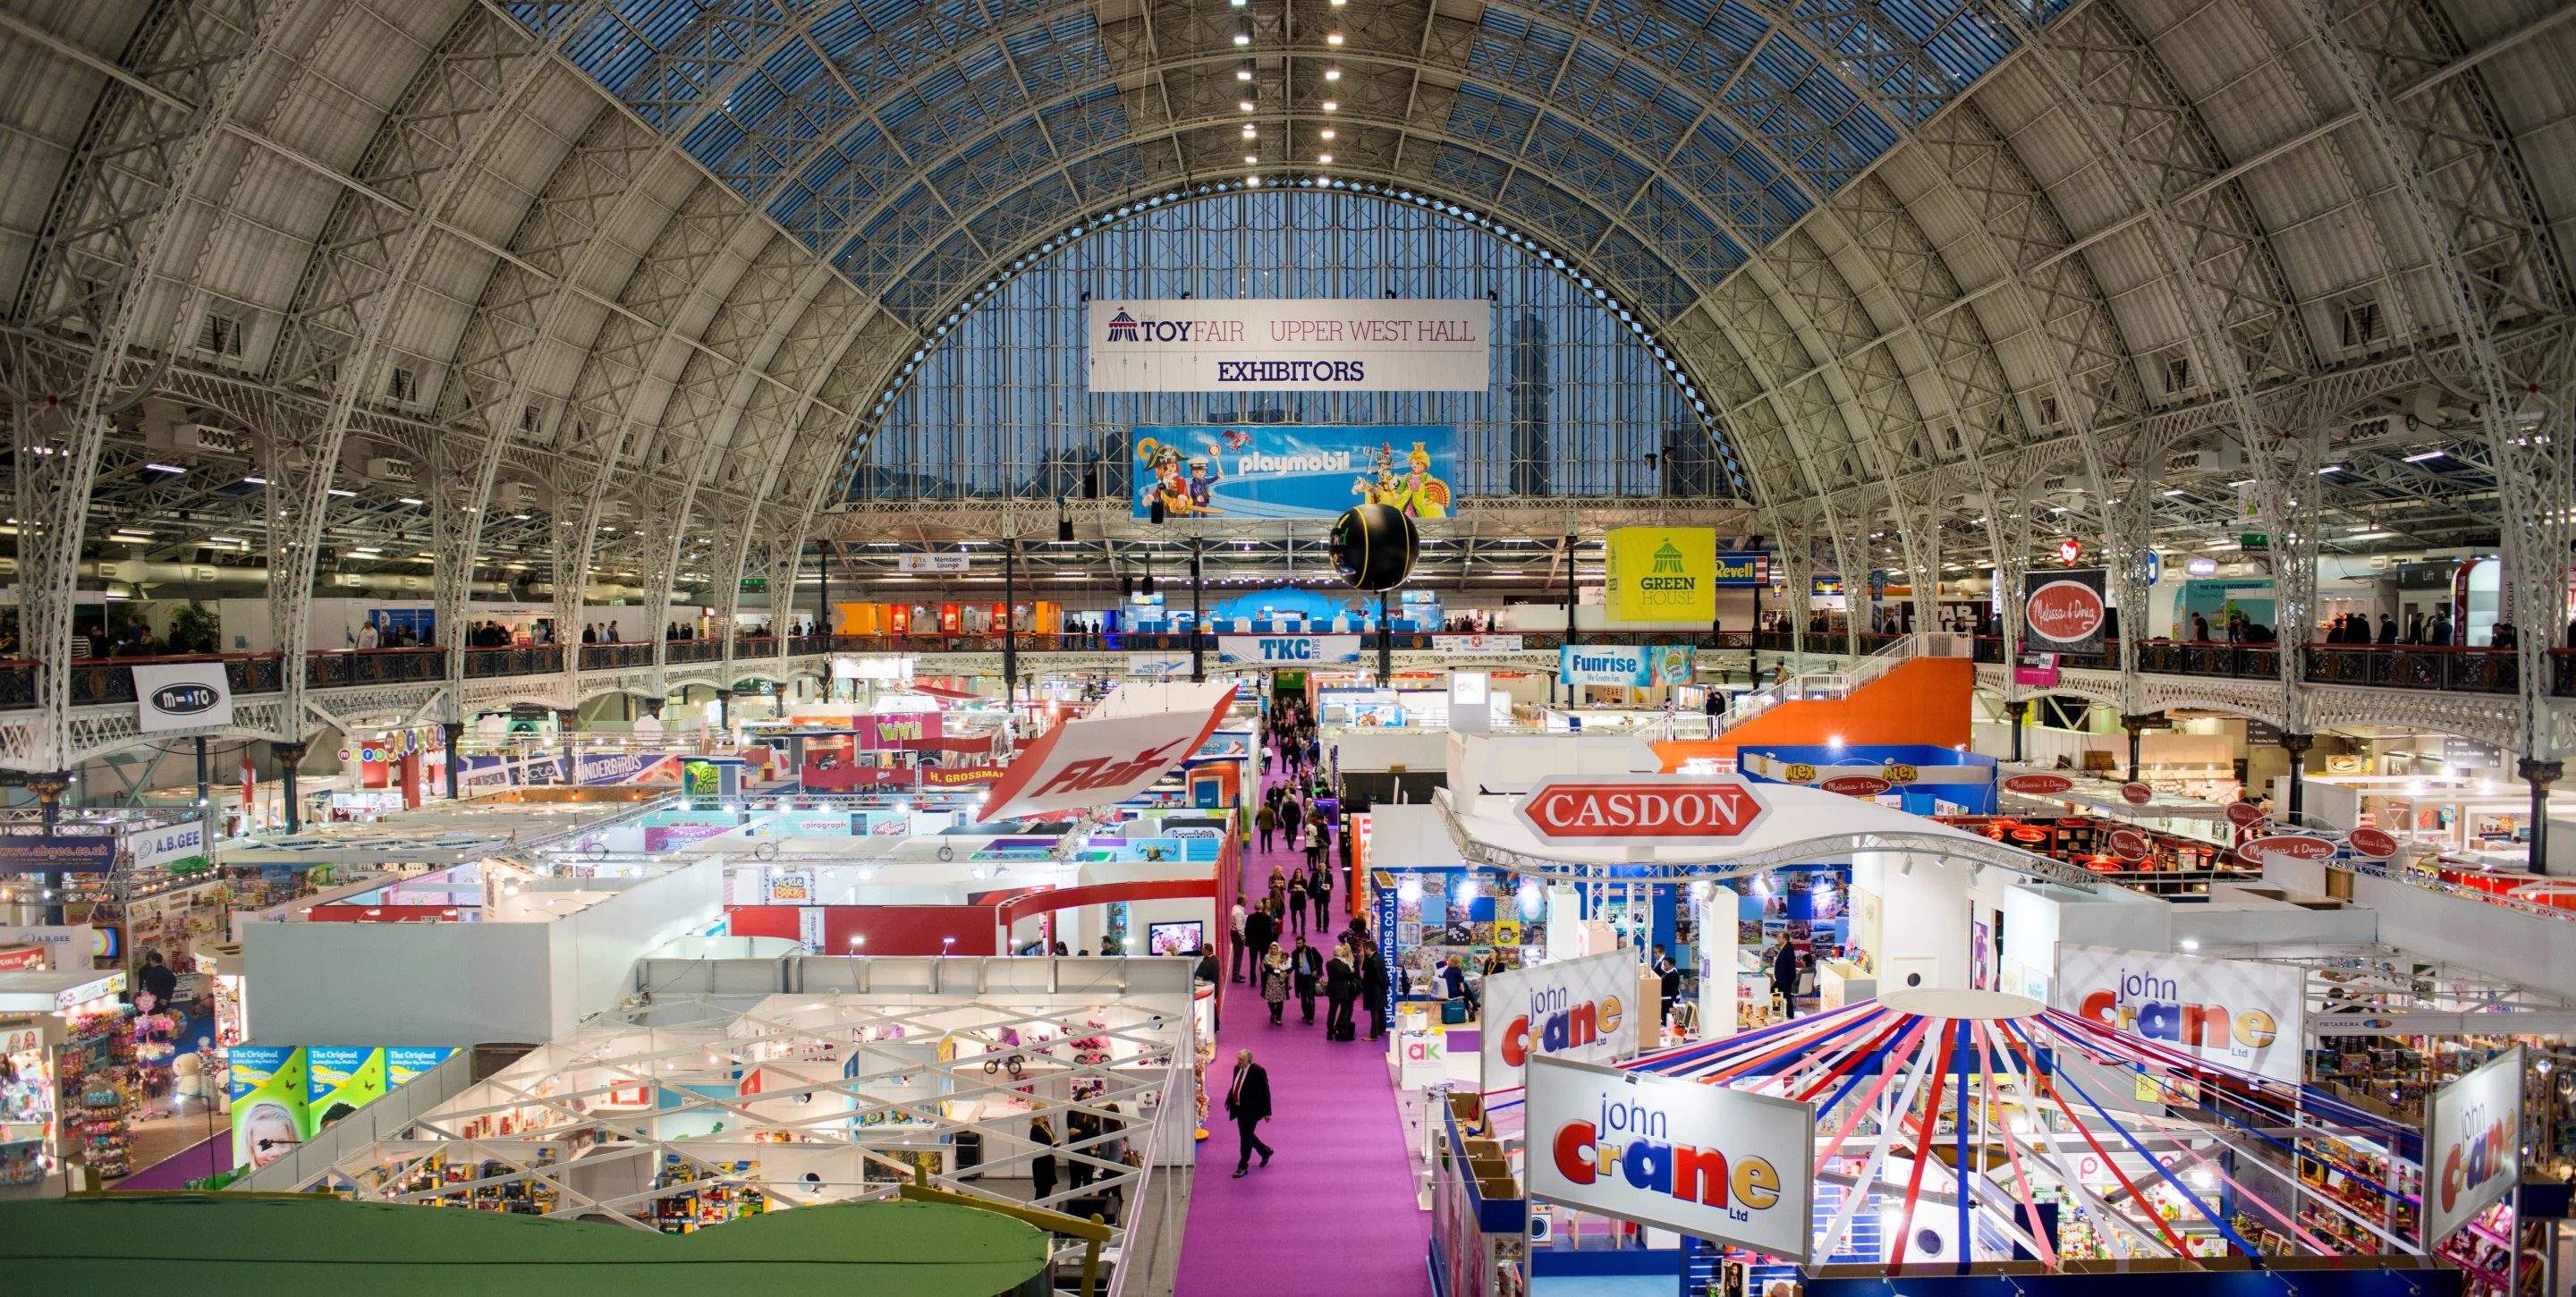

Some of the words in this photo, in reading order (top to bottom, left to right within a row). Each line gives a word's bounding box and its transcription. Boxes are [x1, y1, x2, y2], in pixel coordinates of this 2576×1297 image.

[1270, 320, 1343, 342] UPPER
[1348, 320, 1413, 342] WEST
[1418, 320, 1476, 342] HALL
[1217, 360, 1365, 383] EXHIBITORS
[1238, 451, 1350, 477] playmobil
[1715, 559, 1754, 579] Revell
[2422, 571, 2435, 581] Lift
[1640, 577, 1696, 591] GREEN
[1816, 581, 1838, 592] Revell
[1641, 591, 1696, 606] HOUSE
[2033, 598, 2066, 626] Melissa
[2074, 599, 2095, 631] Doug
[1258, 639, 1311, 660] TKC
[1311, 639, 1320, 660] SALES
[1572, 654, 1637, 673] Funrise
[1596, 674, 1610, 682] Create
[1603, 687, 1623, 697] YEARS
[701, 766, 718, 782] Che
[1027, 735, 1191, 799] Flair
[930, 771, 942, 783] H.
[698, 782, 718, 795] Mon
[1827, 781, 1859, 792] Melissa
[1867, 781, 1885, 793] Doug
[2010, 779, 2041, 789] Melissa
[2049, 780, 2067, 791] Doug
[2124, 788, 2138, 797] Melissa
[1545, 793, 1741, 827] CASDON
[2231, 808, 2248, 820] Melissa
[801, 821, 846, 831] spirograph
[155, 830, 199, 854] A.B.GEE
[2113, 835, 2130, 850] Melissa
[2133, 843, 2143, 858] Doug
[2354, 833, 2375, 848] Melissa
[2380, 839, 2394, 854] Doug
[2301, 844, 2327, 859] Doug
[2117, 968, 2177, 1004] john
[1530, 983, 1567, 1025] john
[2079, 988, 2277, 1050] crane
[1501, 994, 1623, 1068] crane
[1597, 1037, 1607, 1047] Ltd
[232, 1050, 246, 1058] The
[247, 1050, 278, 1060] Original
[311, 1050, 325, 1059] The
[326, 1050, 358, 1060] Original
[389, 1050, 403, 1059] The
[404, 1050, 436, 1062] Original
[2231, 1047, 2249, 1059] Ltd
[235, 1072, 256, 1080] Insect
[315, 1072, 335, 1080] Insect
[1599, 1091, 1667, 1140] john
[2460, 1100, 2485, 1157] john
[1553, 1118, 1782, 1211] crane
[2441, 1108, 2516, 1214] crane
[1728, 1208, 1749, 1223] Ltd
